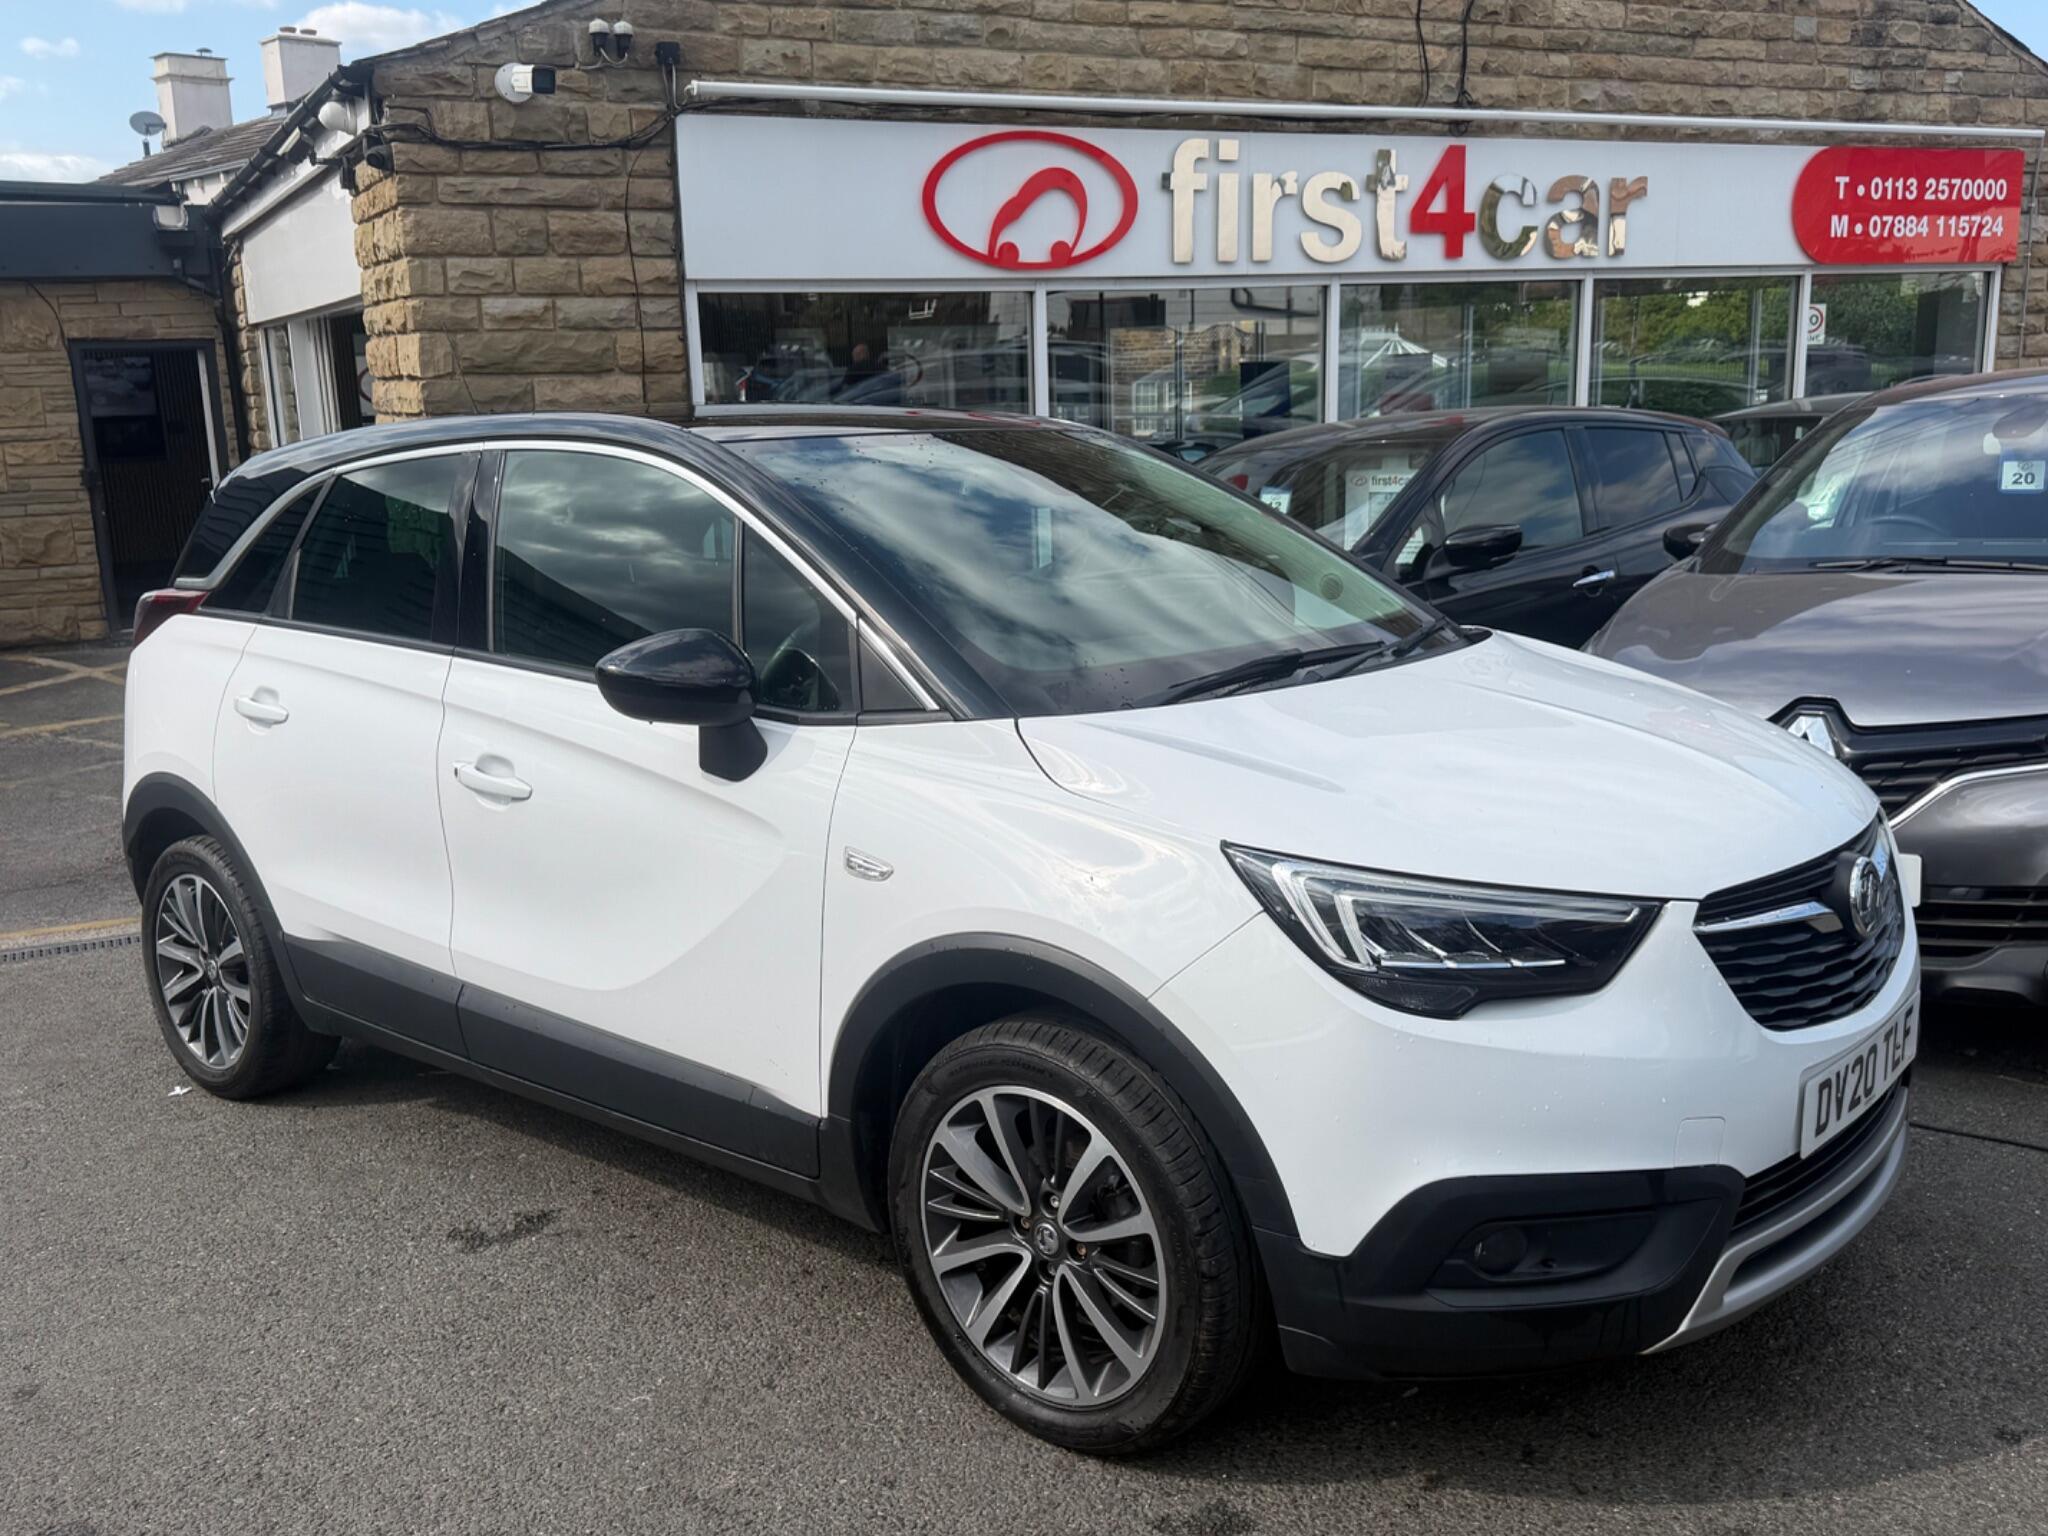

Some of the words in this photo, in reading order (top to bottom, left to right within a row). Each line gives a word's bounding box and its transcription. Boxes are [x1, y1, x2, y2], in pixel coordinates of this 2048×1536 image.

[1162, 138, 1648, 263] first4car
[1835, 176, 1850, 200] T
[1870, 177, 1918, 200] 0113
[1924, 178, 2008, 201] 2570000
[1830, 214, 1848, 238] M
[1868, 215, 1929, 237] 07884
[1936, 215, 2004, 237] 115724
[1371, 474, 1410, 487] first4c
[2011, 471, 2036, 485] 20
[1815, 1042, 1878, 1138] DV20
